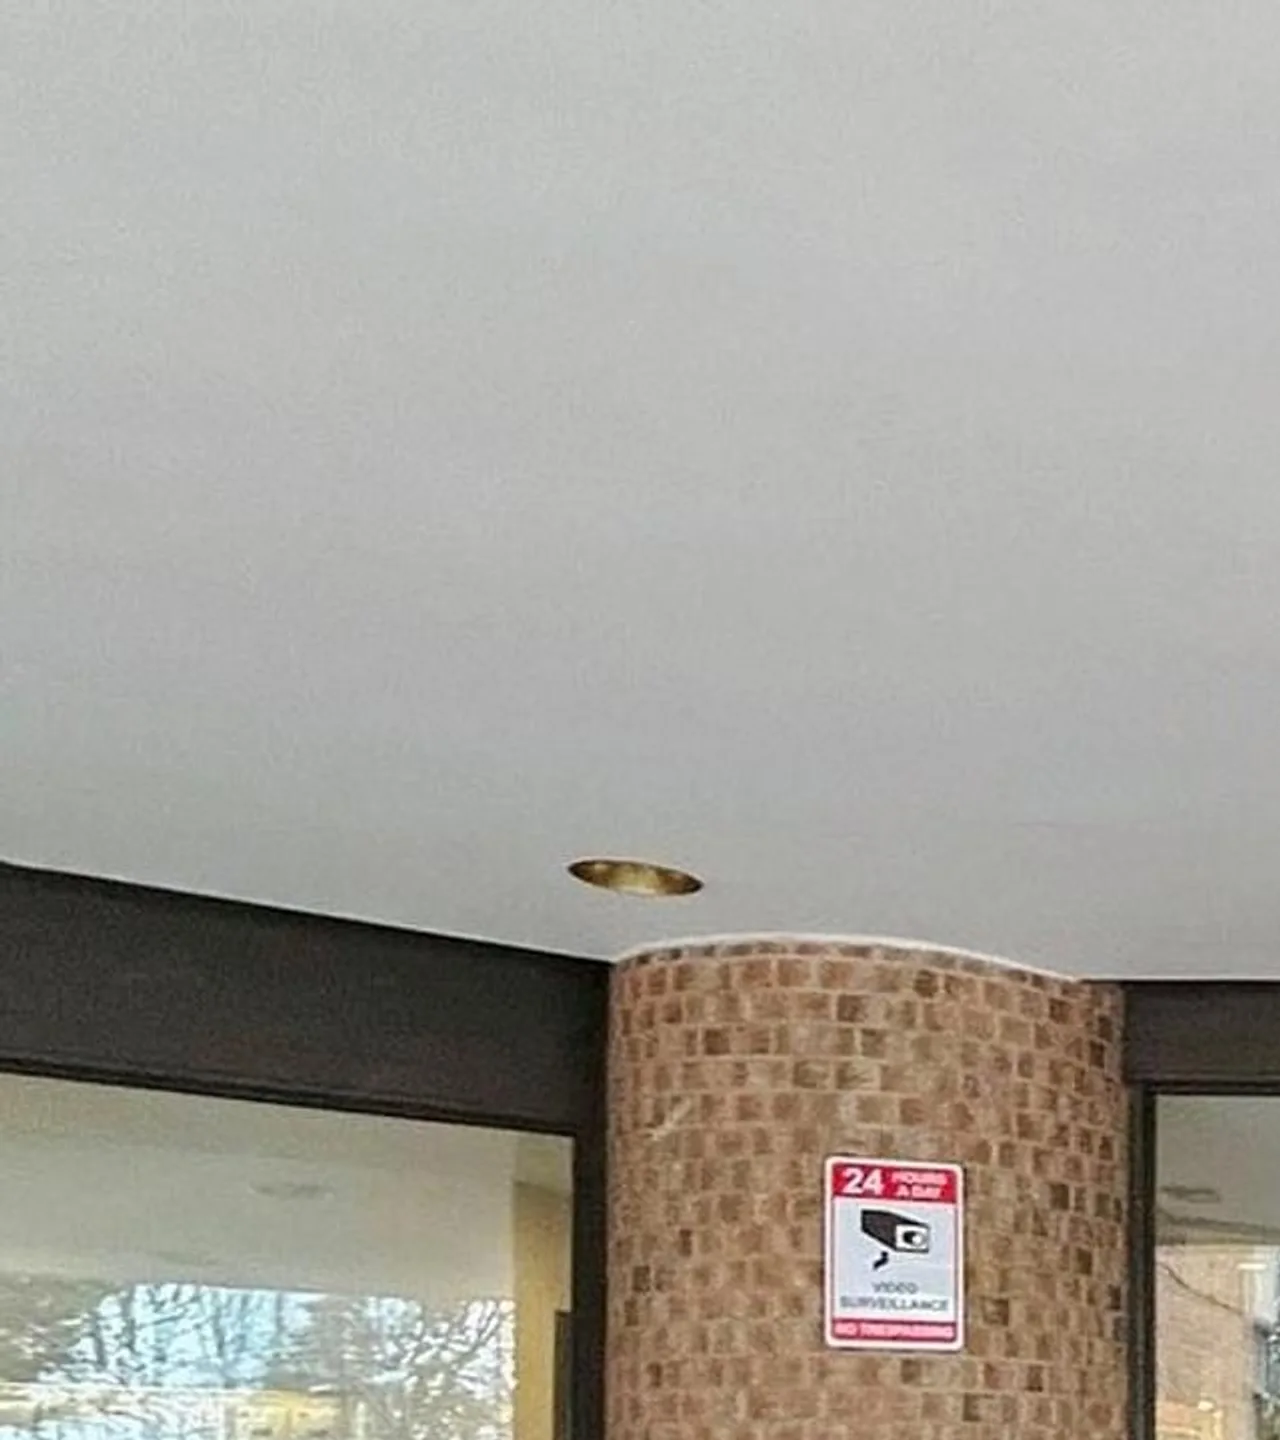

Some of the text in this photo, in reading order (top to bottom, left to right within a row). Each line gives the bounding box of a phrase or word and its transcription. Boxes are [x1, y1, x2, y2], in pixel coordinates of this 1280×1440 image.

[841, 1168, 884, 1195] 24
[872, 1282, 919, 1294] VIDEO
[840, 1297, 949, 1312] SURVEILLANCE
